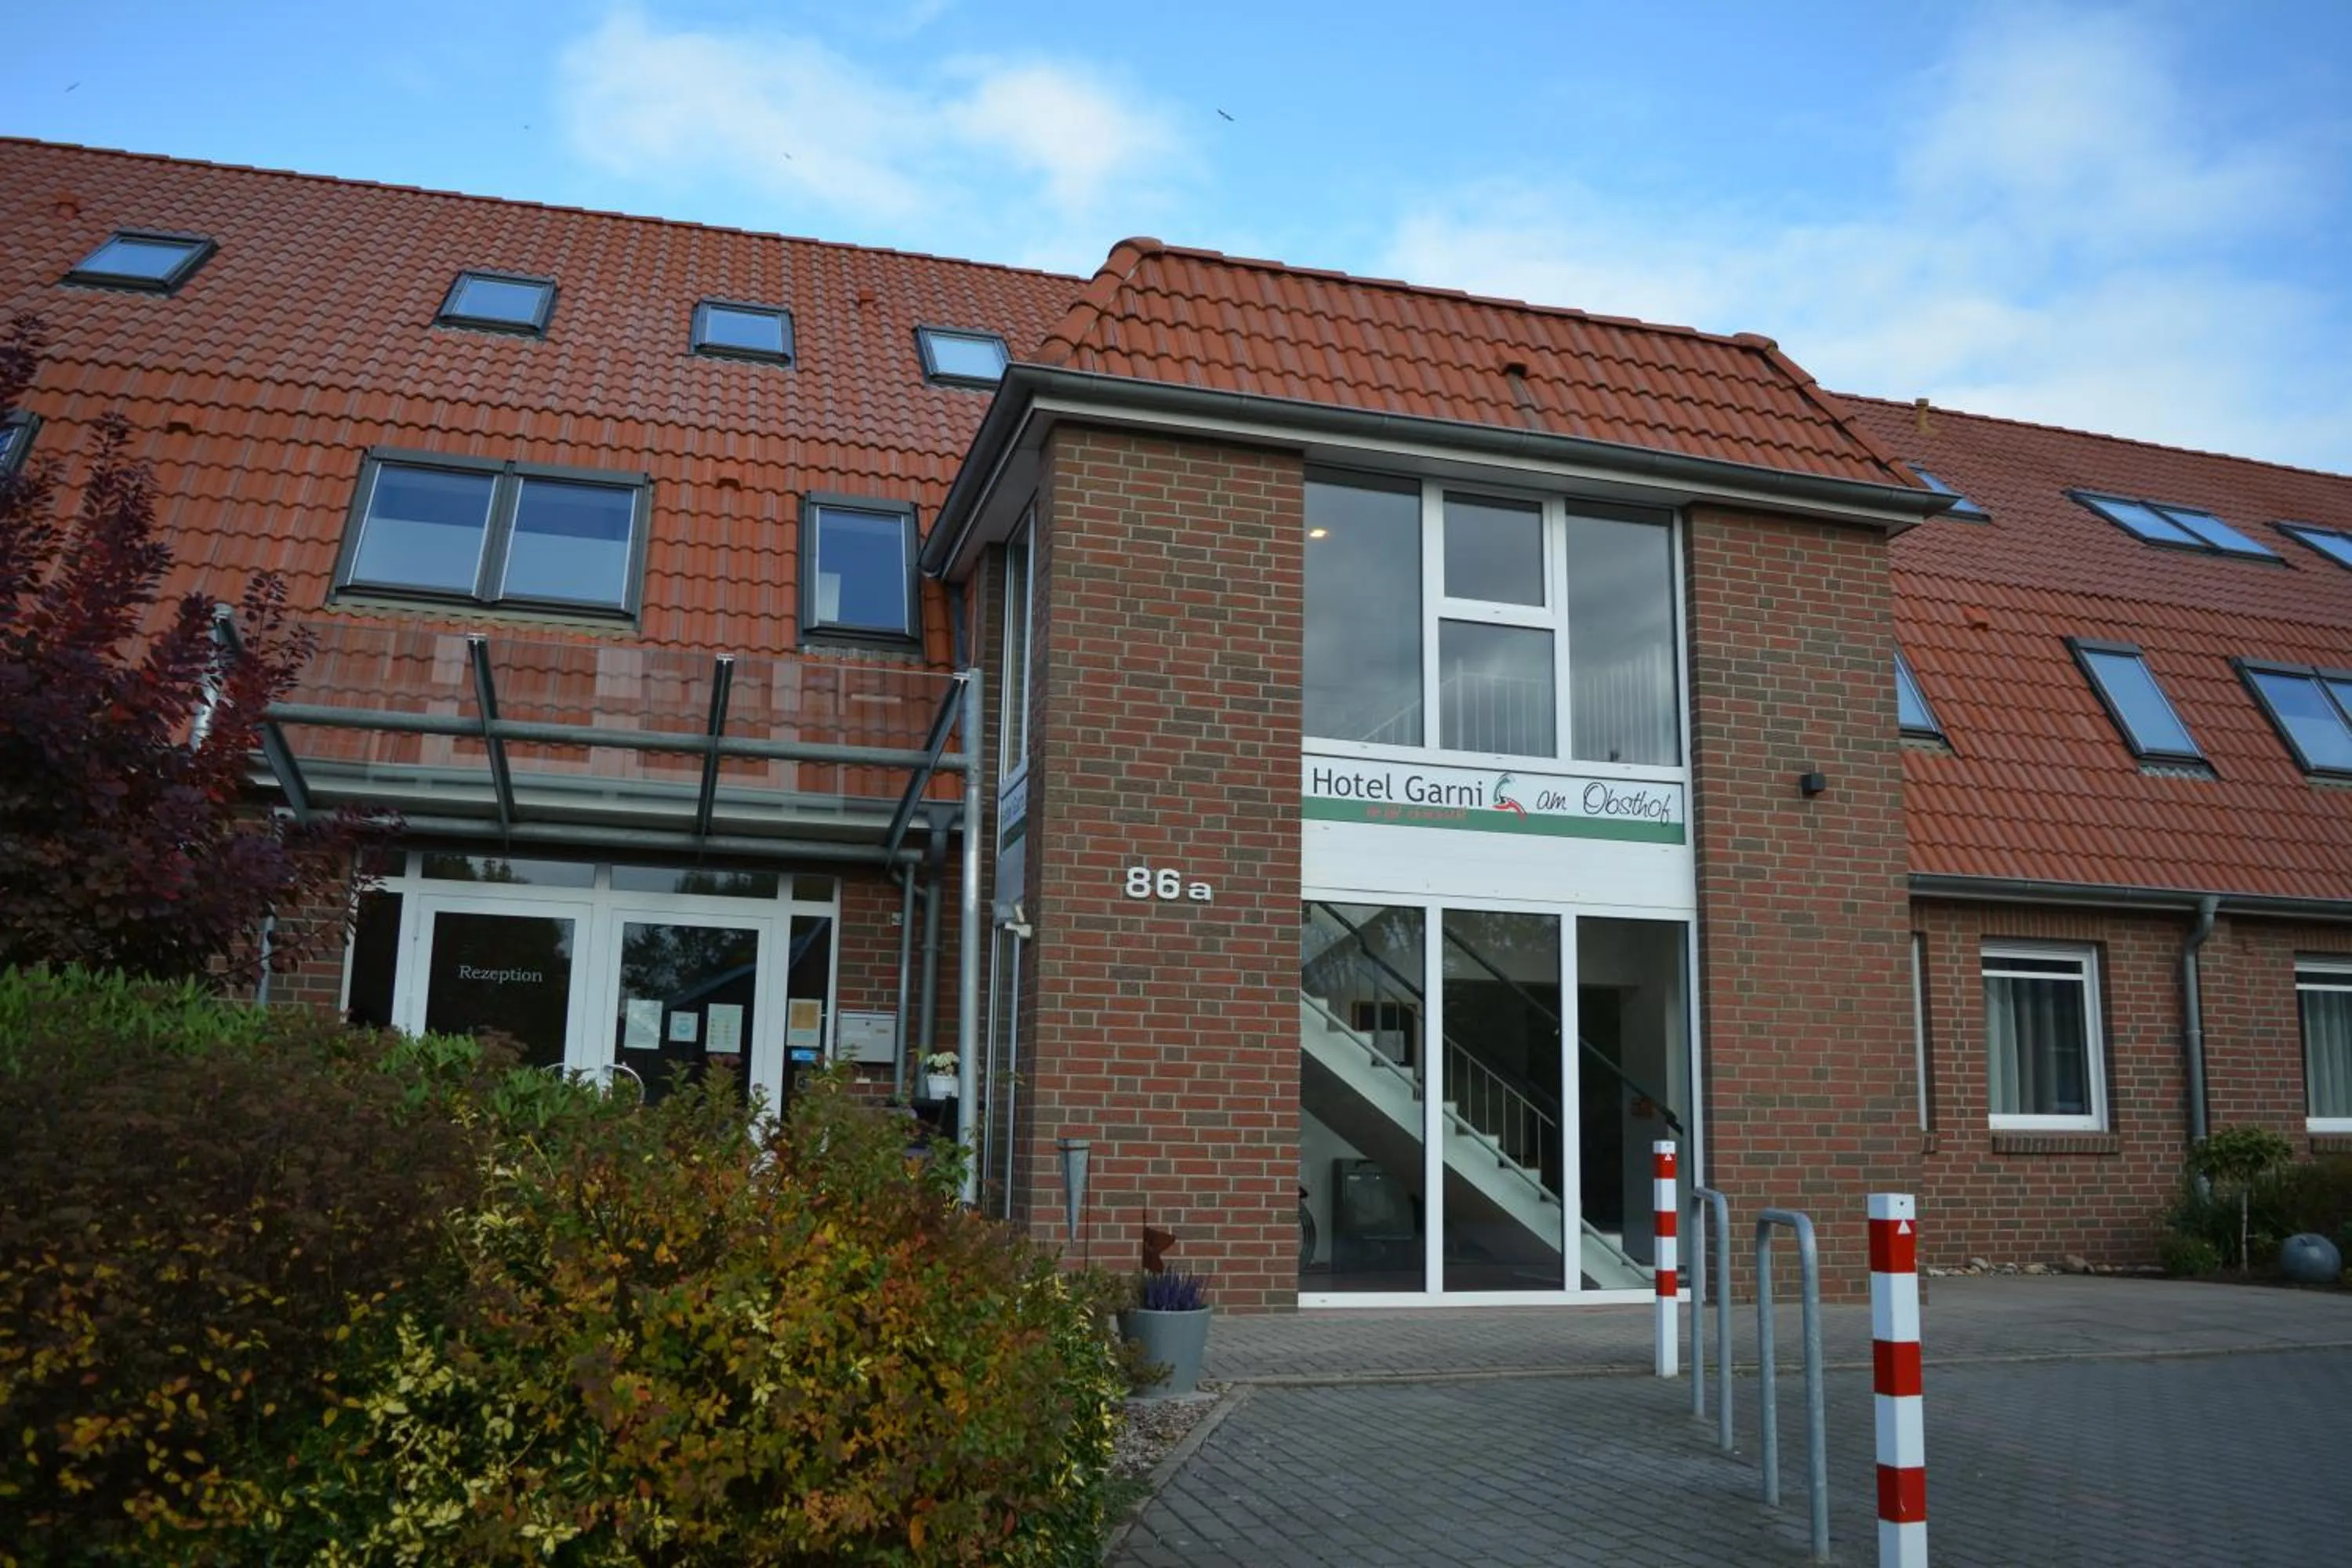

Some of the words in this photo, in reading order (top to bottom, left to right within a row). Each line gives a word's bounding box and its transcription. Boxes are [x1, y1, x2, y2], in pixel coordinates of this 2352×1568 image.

[1313, 767, 1393, 800] Hotel
[1405, 775, 1483, 807] Garni
[1536, 789, 1567, 811] am
[1583, 782, 1671, 828] Obsthof
[458, 964, 543, 985] Rezeption
